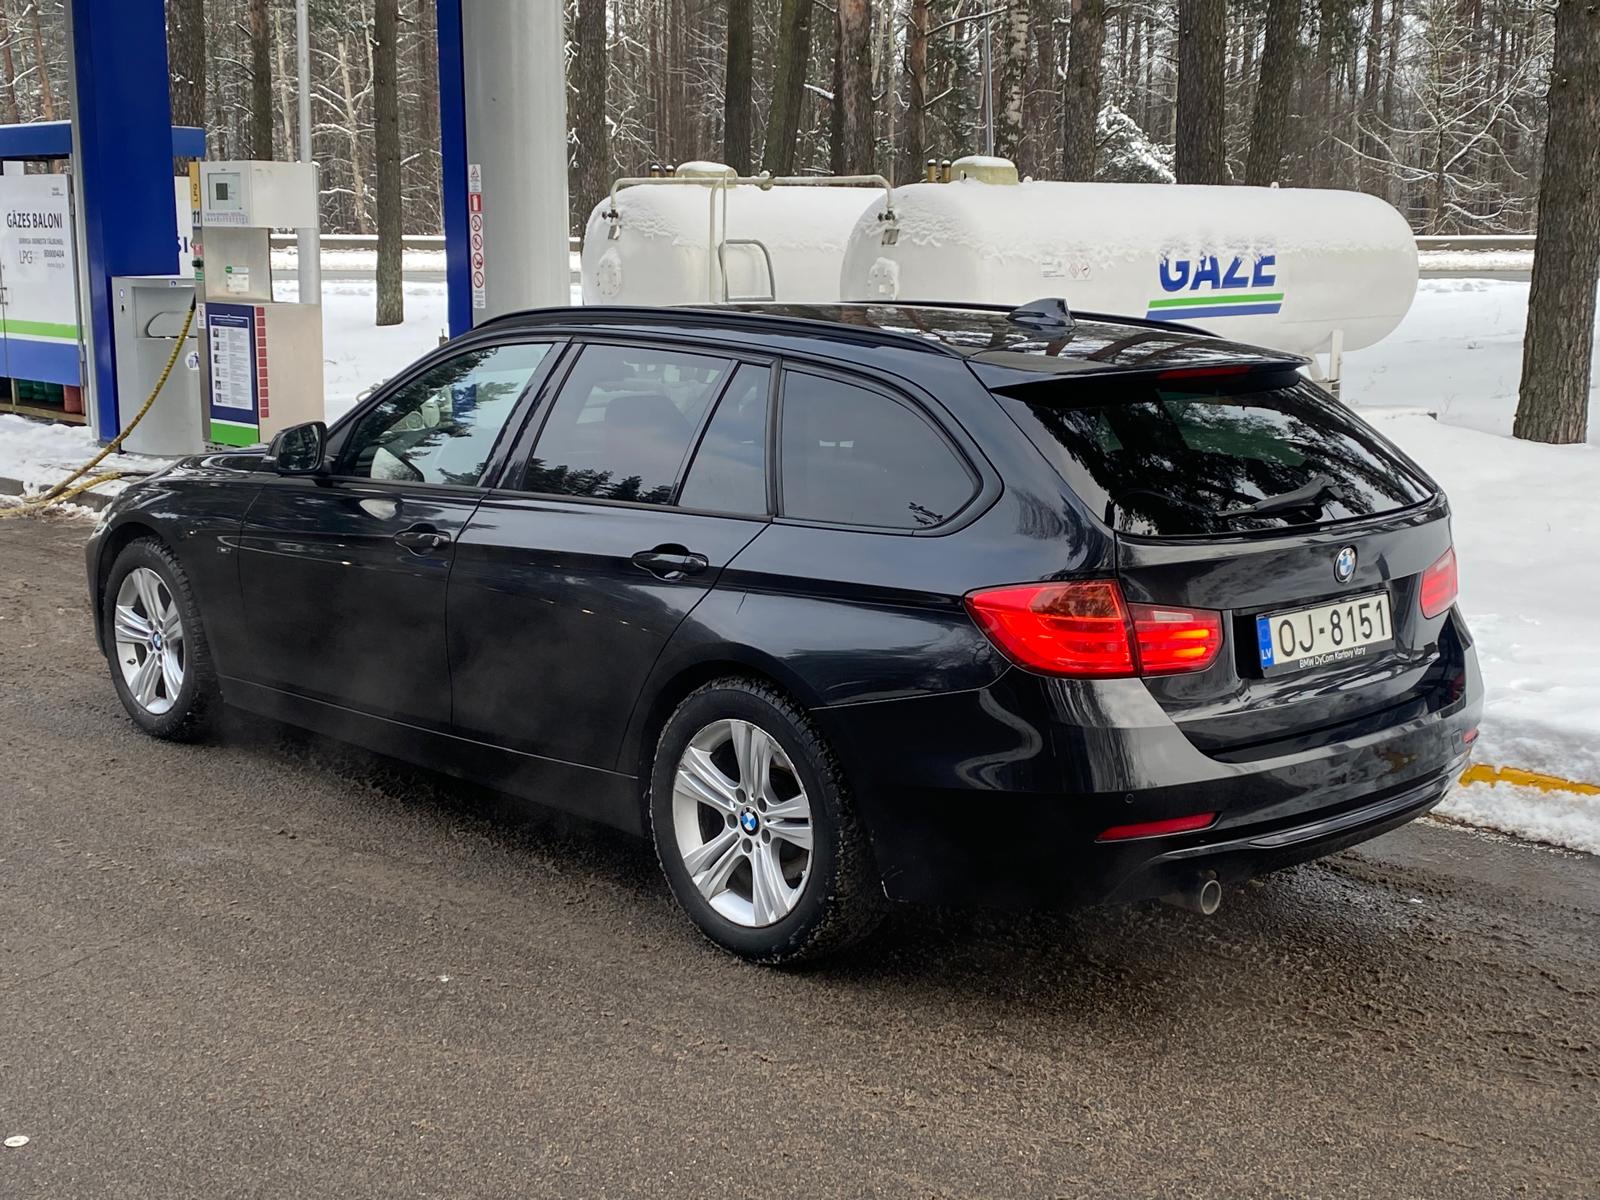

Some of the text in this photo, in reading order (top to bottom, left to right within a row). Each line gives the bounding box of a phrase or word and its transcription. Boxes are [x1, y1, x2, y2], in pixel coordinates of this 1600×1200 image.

[6, 210, 63, 229] GĀZES BALONI
[192, 210, 200, 224] 11
[1278, 600, 1386, 657] OJ-8151
[1261, 648, 1272, 660] LV
[1299, 657, 1314, 669] BMW
